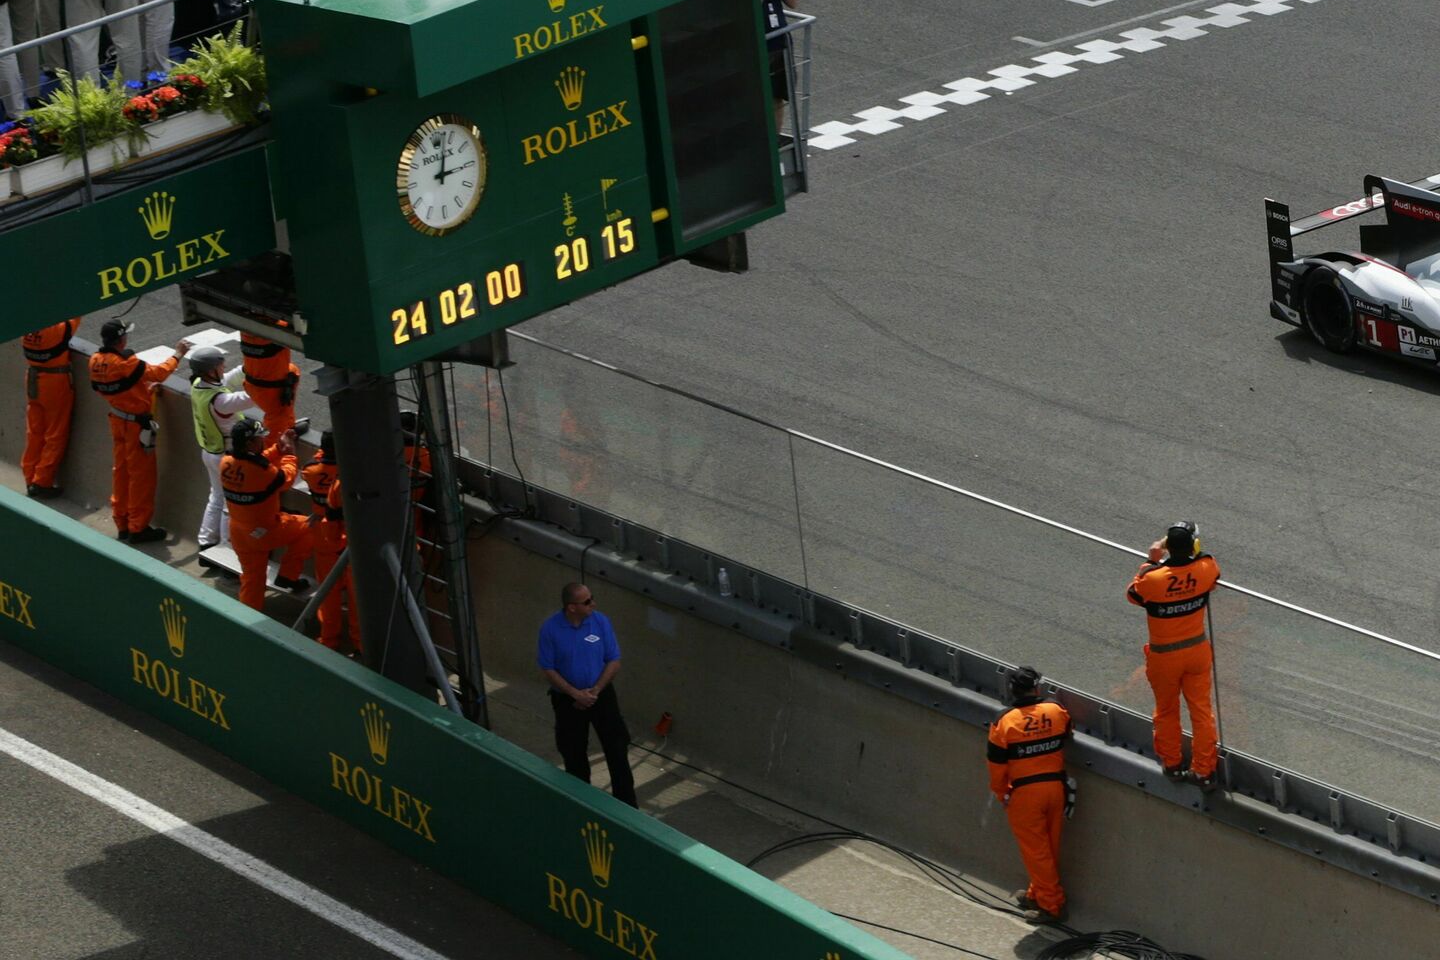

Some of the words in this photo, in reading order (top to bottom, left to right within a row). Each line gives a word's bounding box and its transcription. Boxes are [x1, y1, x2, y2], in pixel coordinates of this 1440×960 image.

[513, 5, 608, 59] ROLEX
[521, 100, 632, 166] ROLEX
[1394, 199, 1411, 210] Audi
[1412, 205, 1434, 218] e-tron
[554, 237, 590, 280] 20
[601, 217, 636, 259] 15
[1271, 236, 1288, 248] ORIS
[97, 229, 230, 300] ROLEX
[391, 300, 429, 346] 24
[439, 282, 477, 326] 02
[486, 263, 522, 307] 00
[1367, 320, 1383, 347] 1
[1401, 328, 1414, 343] P1
[1167, 572, 1197, 593] 24h
[1166, 597, 1205, 615] DUNLOP
[130, 647, 231, 731] ROLEX
[1022, 713, 1053, 733] 24h
[1025, 740, 1061, 755] DUNLOP
[328, 751, 437, 843] ROLEX
[545, 872, 659, 960] ROLEX
